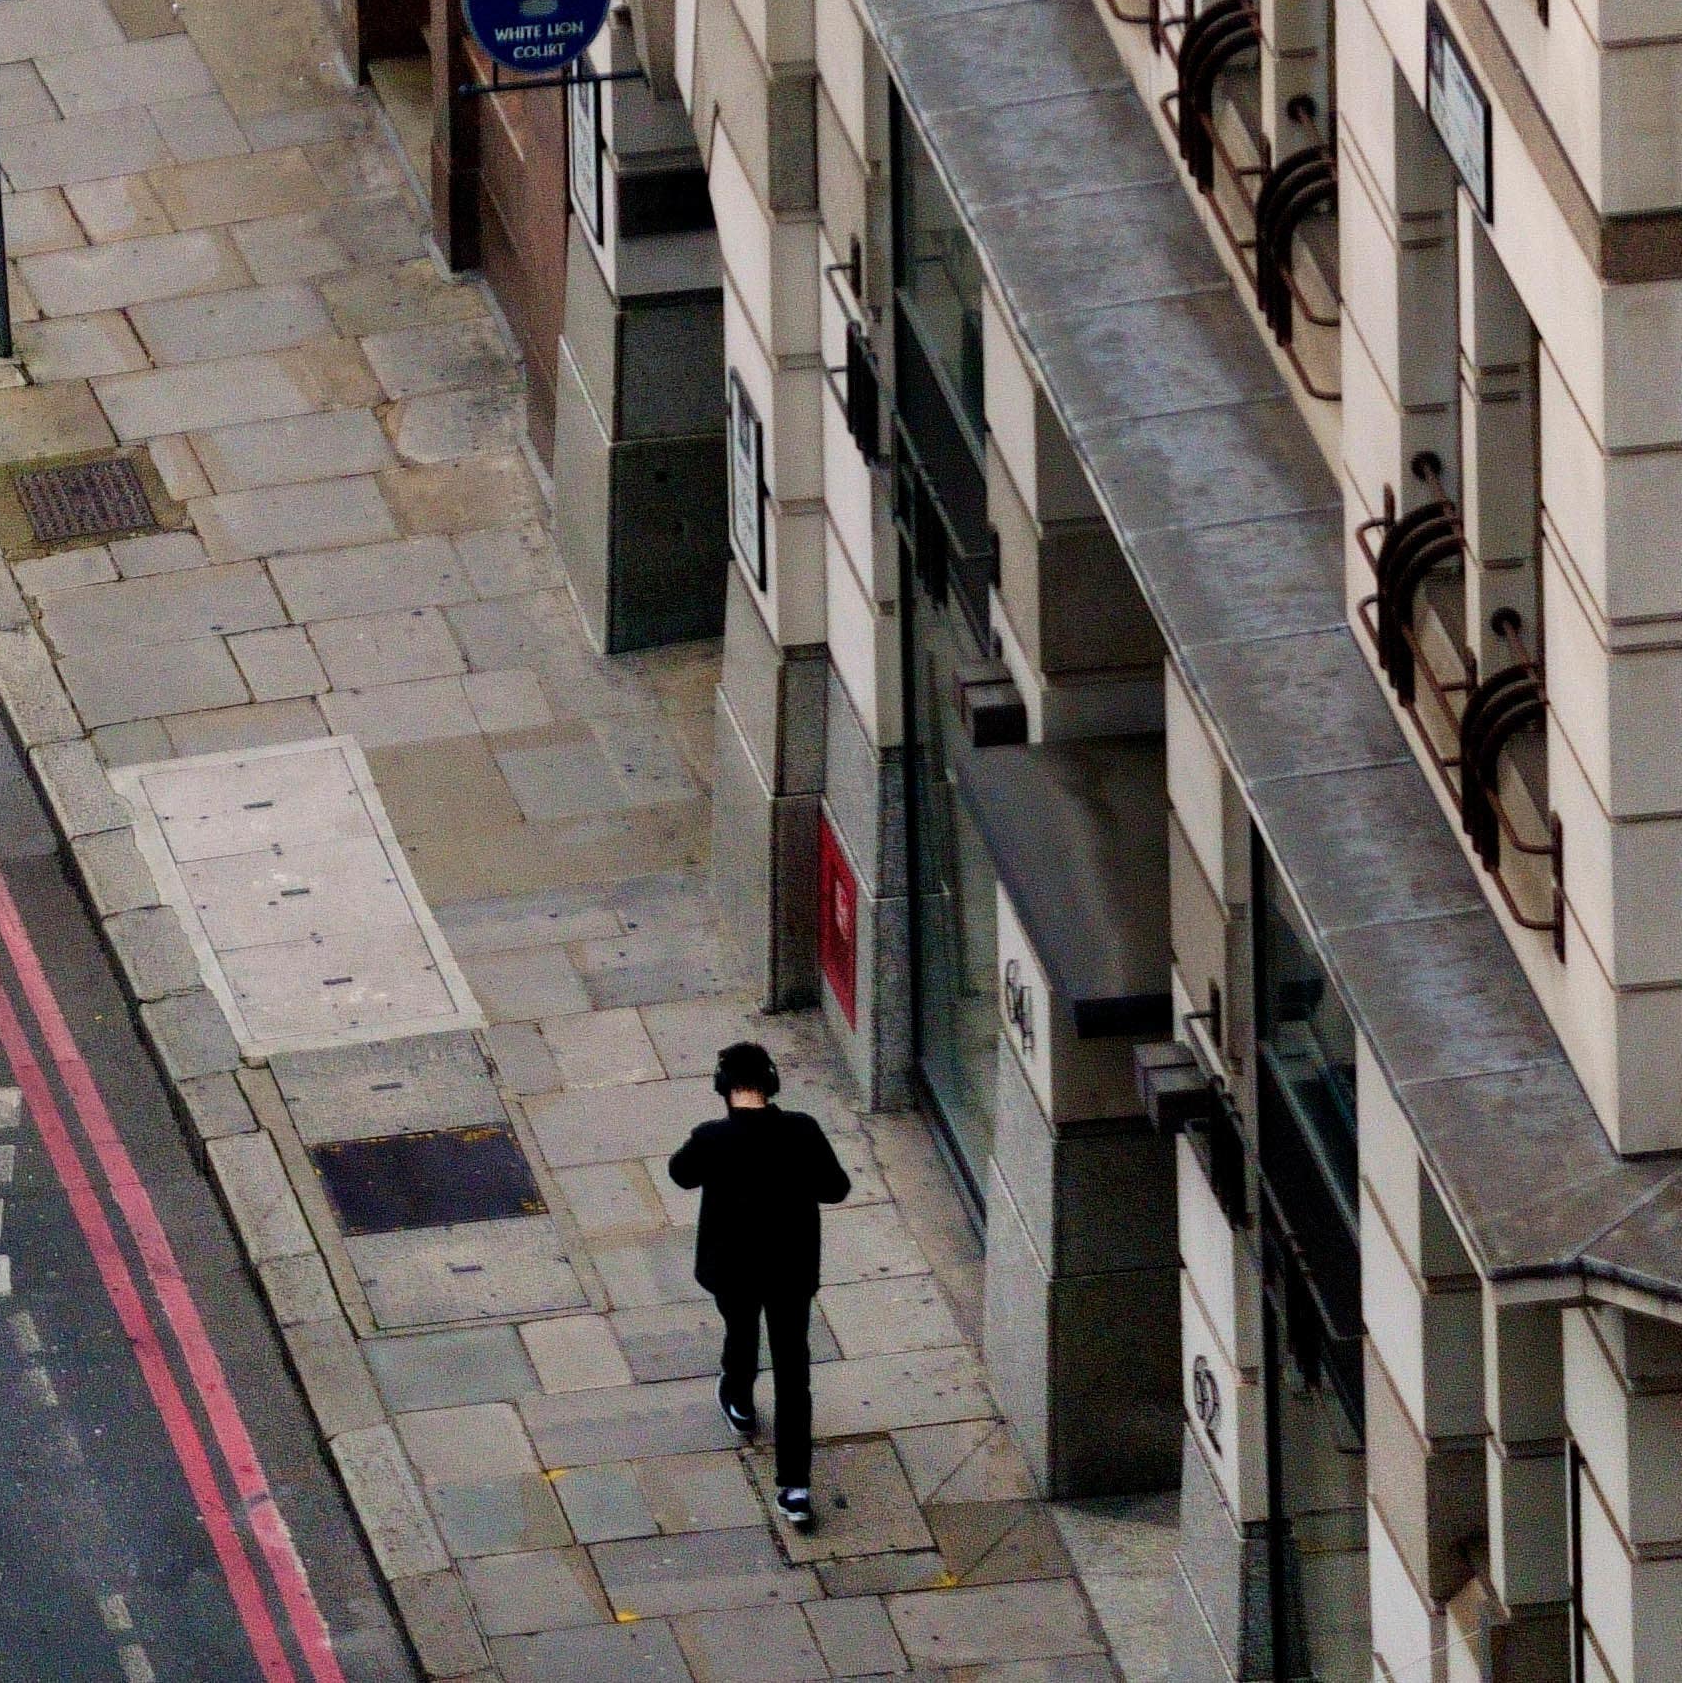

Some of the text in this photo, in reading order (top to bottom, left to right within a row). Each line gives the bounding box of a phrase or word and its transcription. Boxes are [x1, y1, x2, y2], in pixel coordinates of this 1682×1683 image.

[494, 20, 584, 43] WHITE LION
[512, 42, 566, 60] COURT
